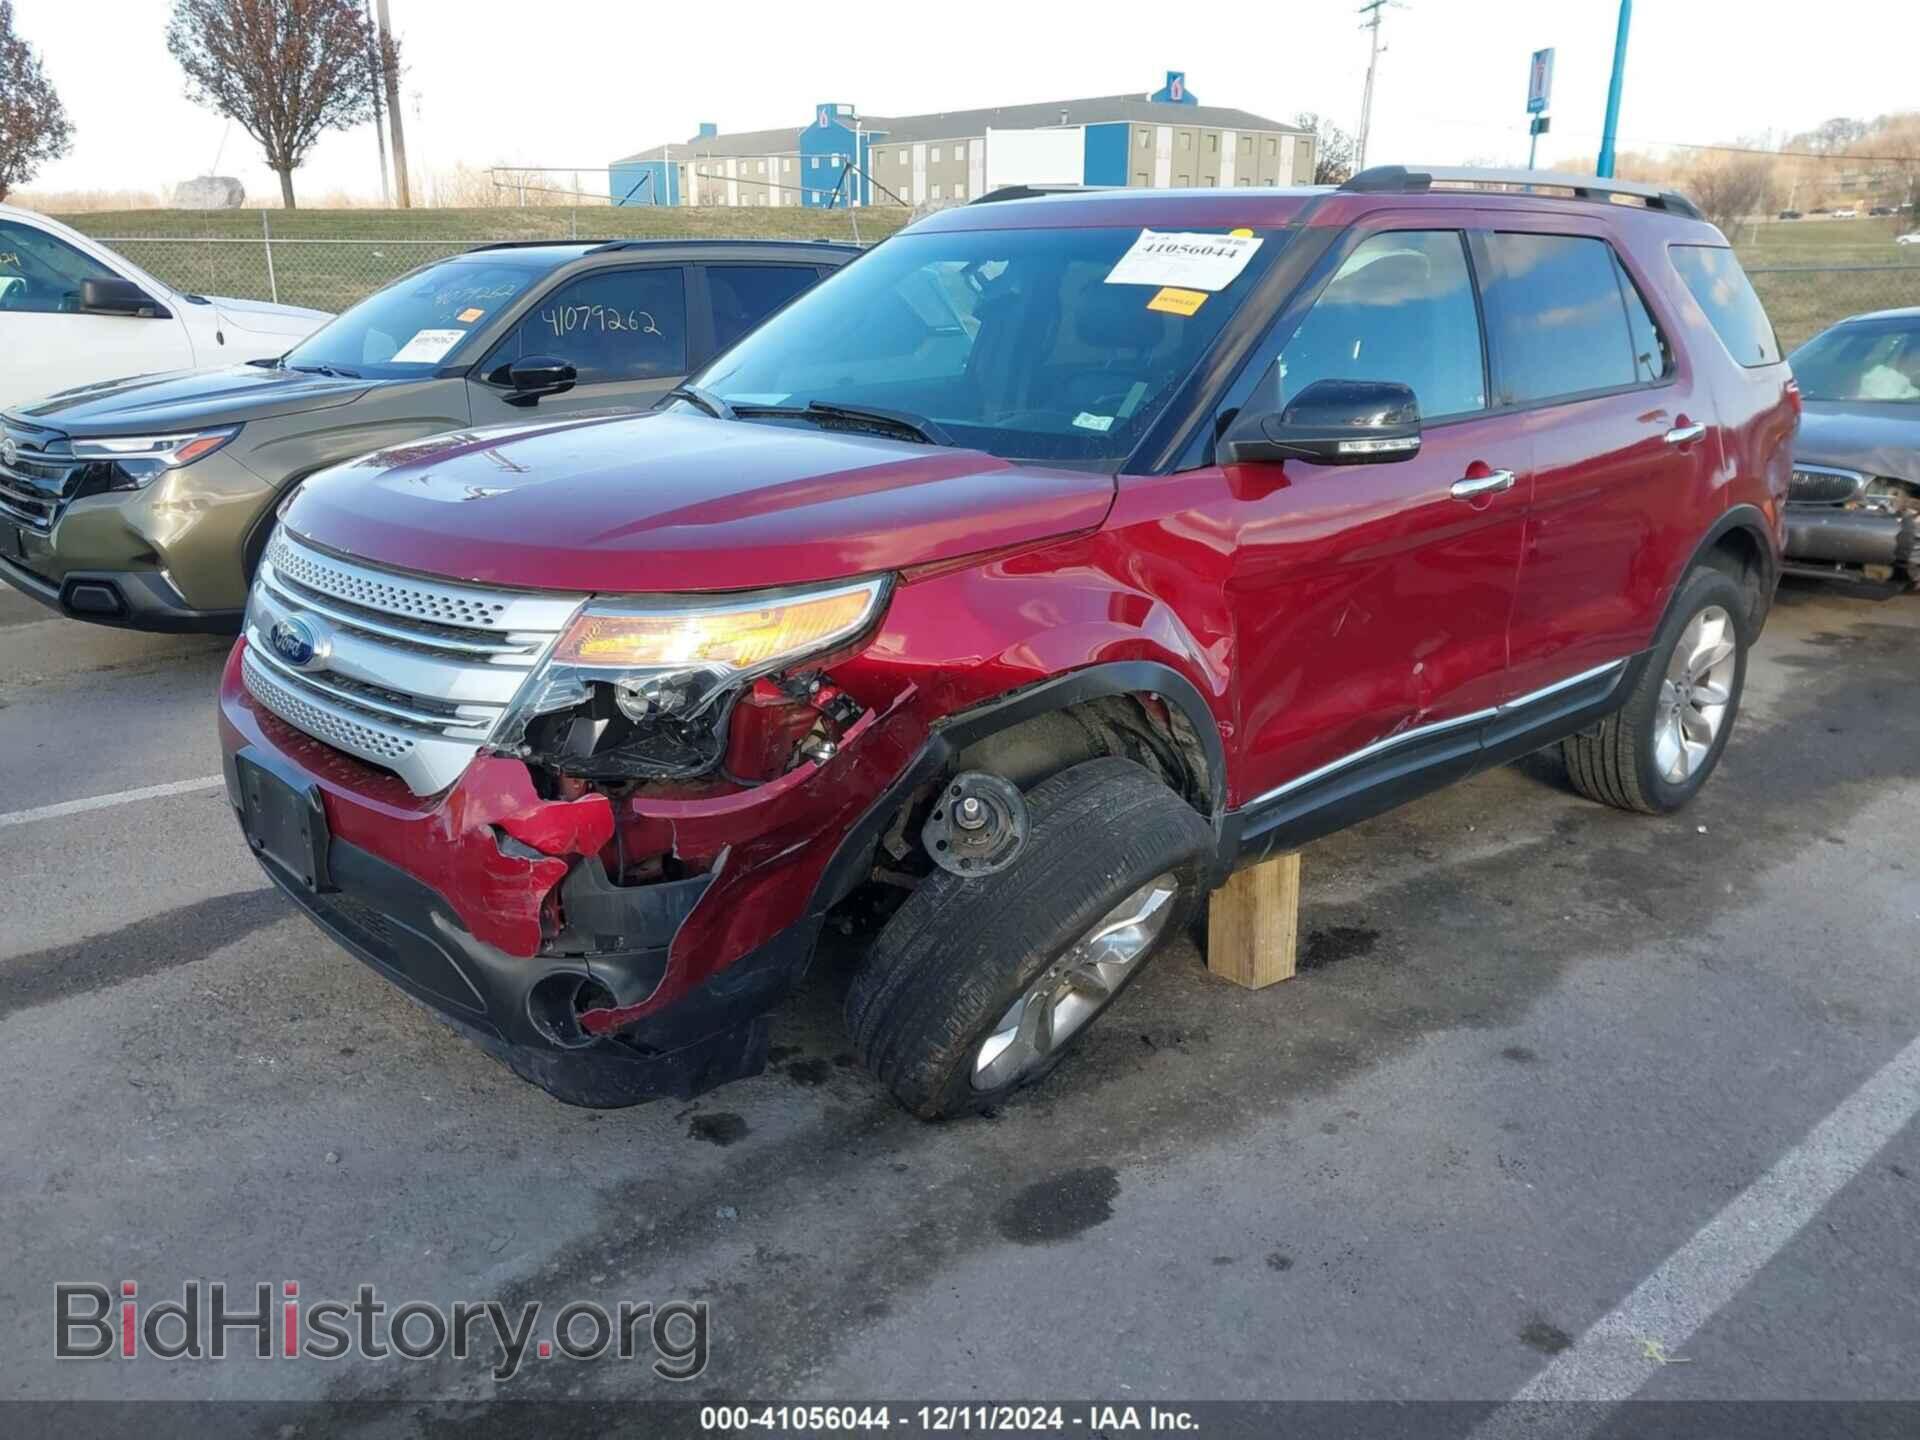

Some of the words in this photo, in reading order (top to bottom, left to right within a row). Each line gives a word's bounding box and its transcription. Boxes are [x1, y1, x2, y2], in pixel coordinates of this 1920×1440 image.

[1142, 242, 1239, 259] 41056044
[541, 304, 662, 336] 41079262
[274, 623, 304, 658] Ford
